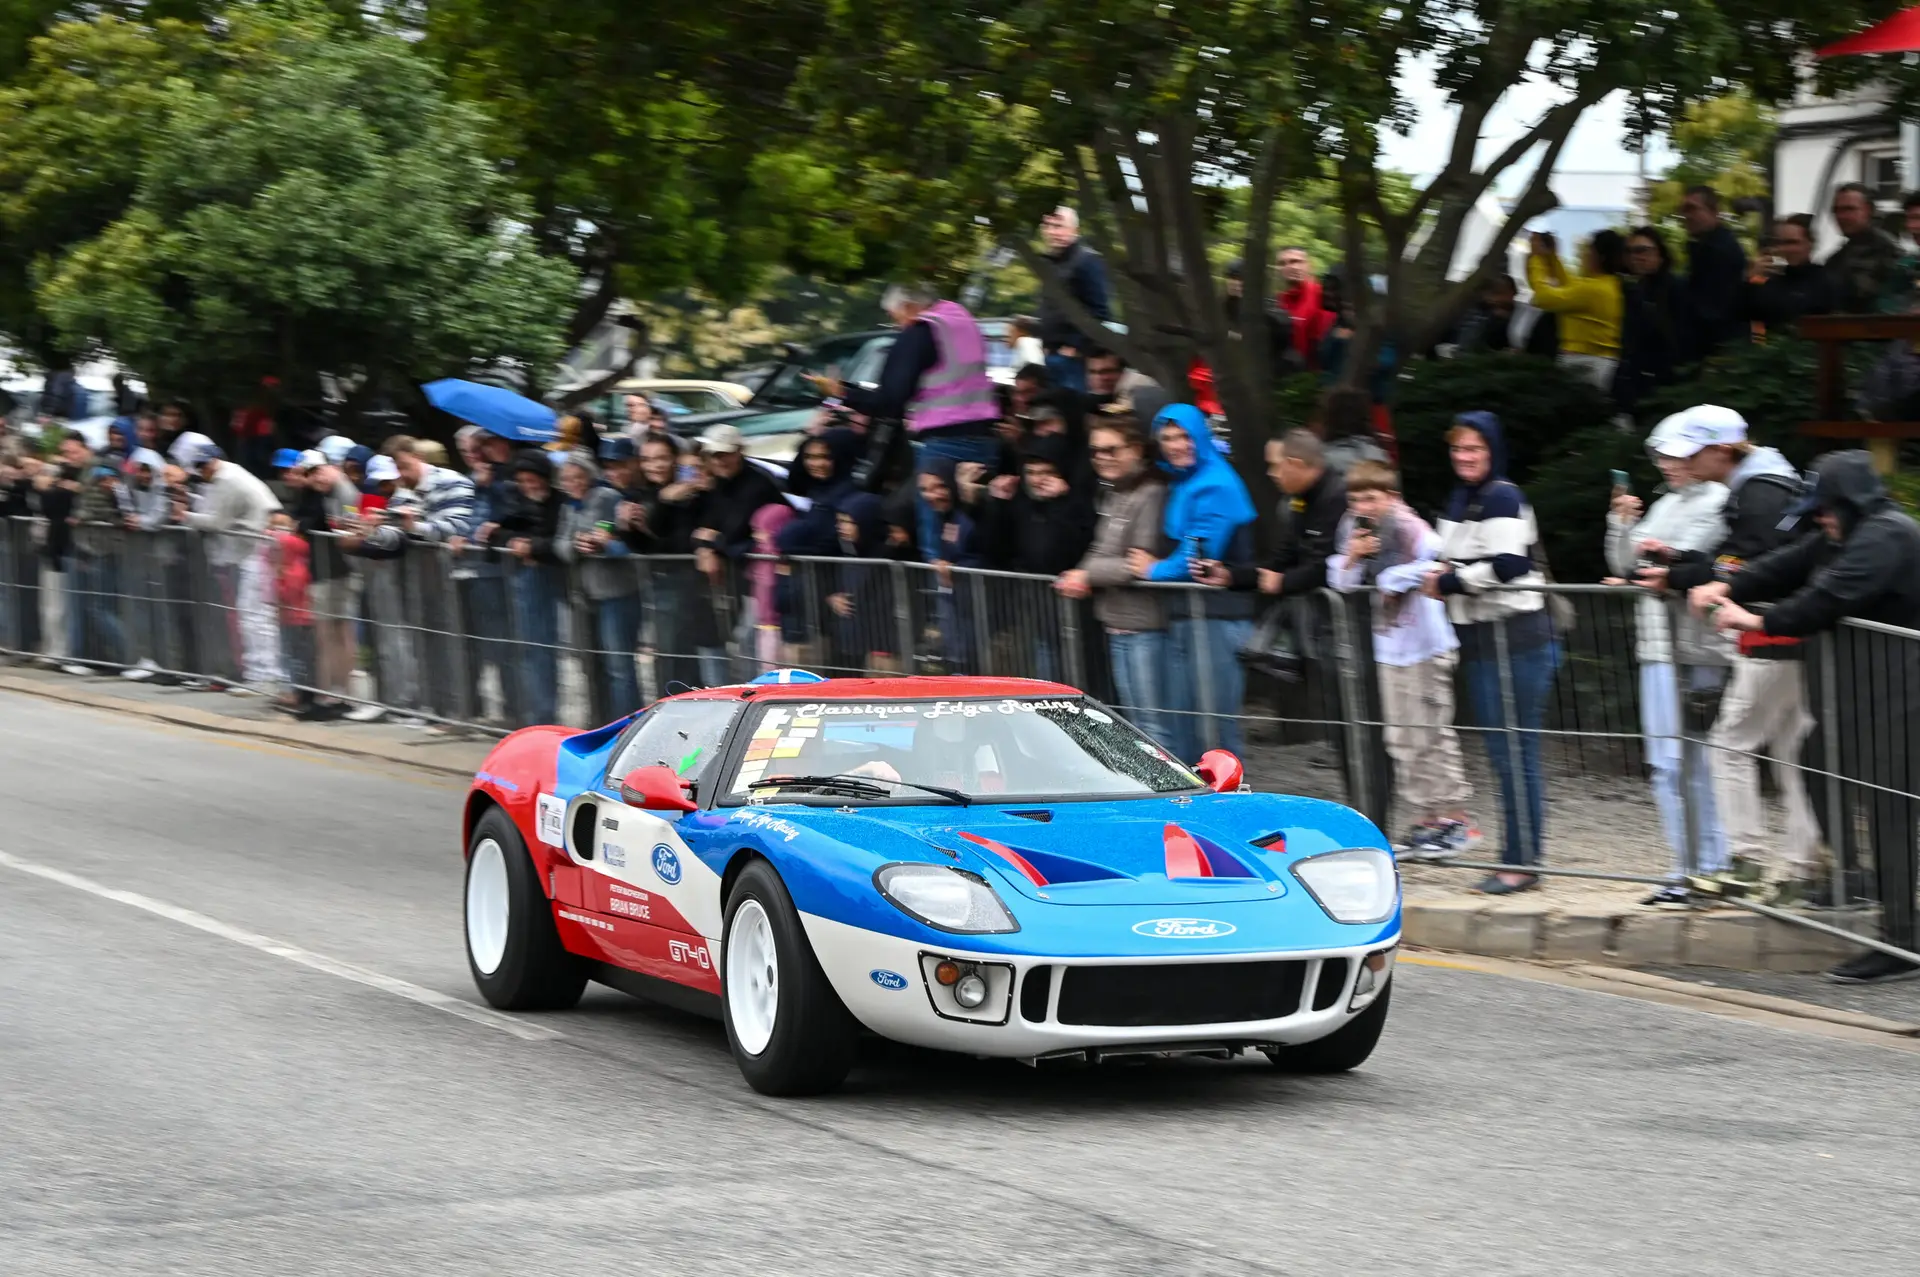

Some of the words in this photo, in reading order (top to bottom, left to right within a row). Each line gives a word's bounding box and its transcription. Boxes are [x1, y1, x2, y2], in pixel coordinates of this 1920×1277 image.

[796, 703, 917, 719] Classique
[923, 701, 992, 719] Edge
[997, 699, 1080, 715] Racing
[656, 847, 678, 879] Ford
[609, 897, 629, 914] BRIAN
[629, 901, 651, 920] BRUCE
[1154, 920, 1219, 936] Ford
[668, 939, 710, 970] GT40
[877, 971, 901, 988] Ford
